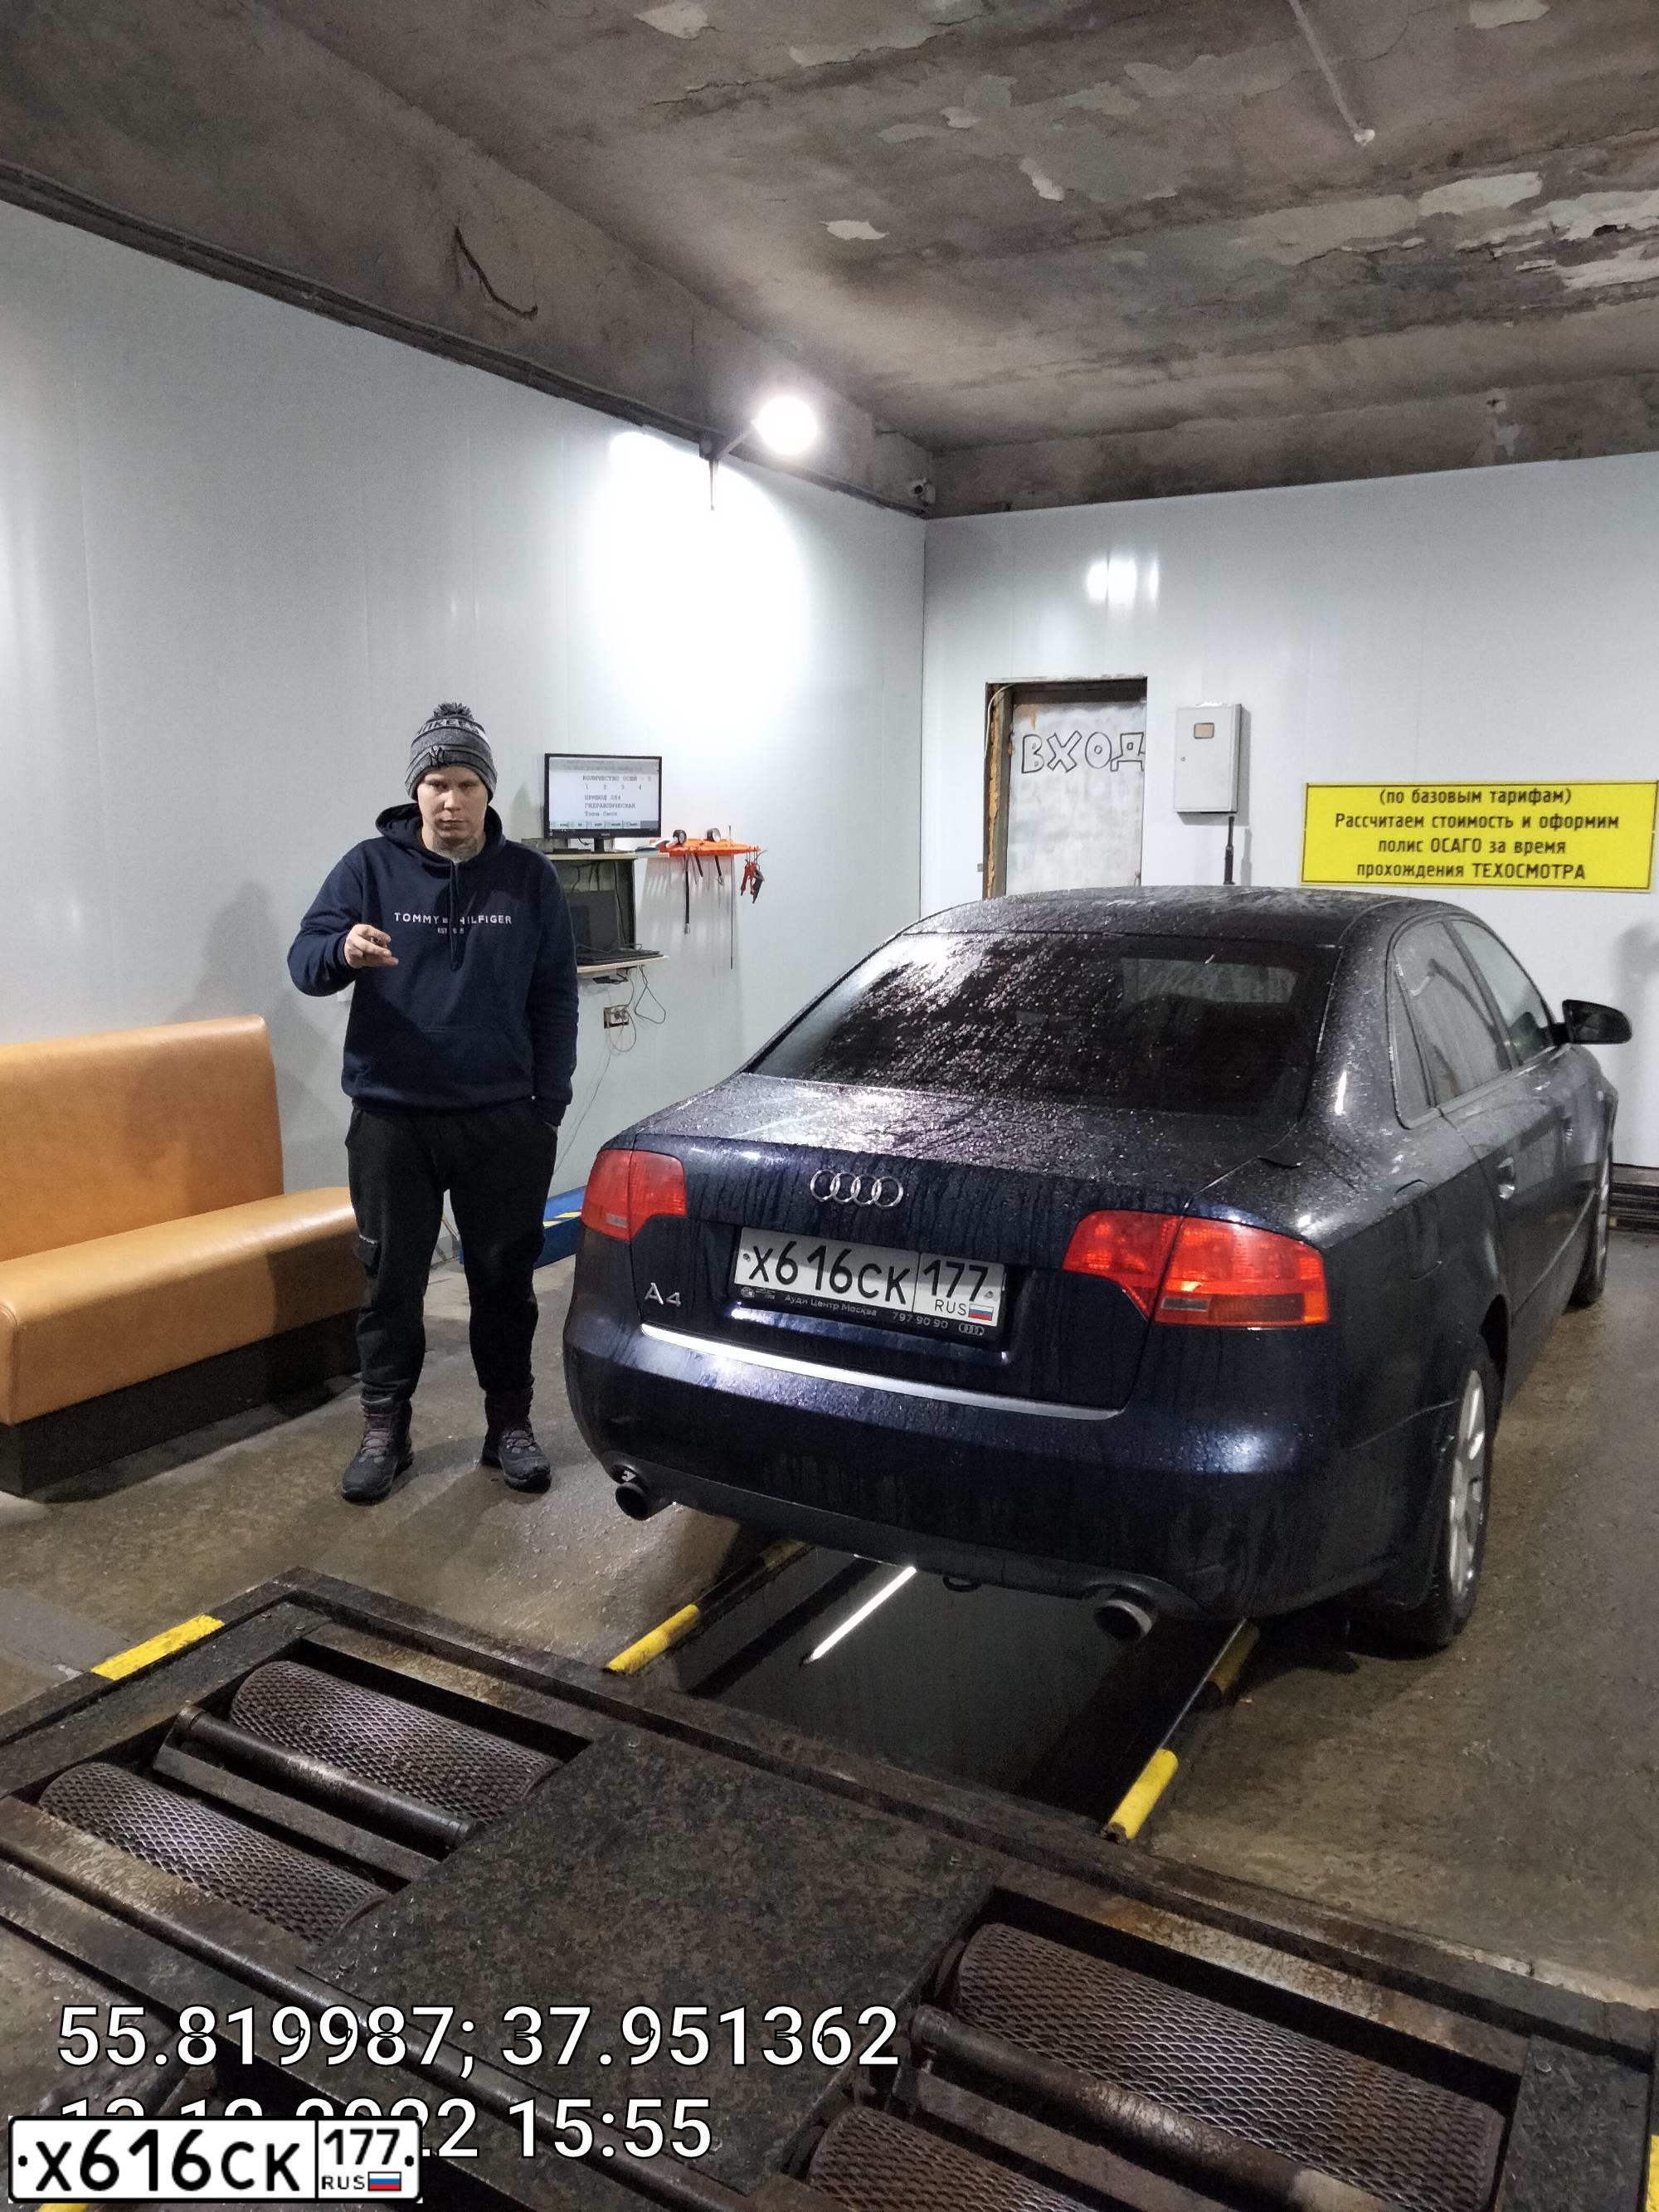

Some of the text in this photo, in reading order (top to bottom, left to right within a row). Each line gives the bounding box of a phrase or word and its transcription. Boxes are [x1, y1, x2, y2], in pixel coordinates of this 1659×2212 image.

[1021, 730, 1146, 773] ВХОД
[1379, 788, 1572, 806] (по базовым тарифам)
[1335, 812, 1619, 831] Рассчитаем стоимость и оформим
[1378, 837, 1566, 857] полис ОСАГО за время
[1356, 862, 1586, 879] прохождения ТЕХОСМОТРА
[394, 912, 439, 924] TOMMY
[922, 1259, 989, 1302] 177
[784, 1295, 949, 1329] Ауди Центр Москва 797 90 90
[935, 1298, 966, 1316] RUS
